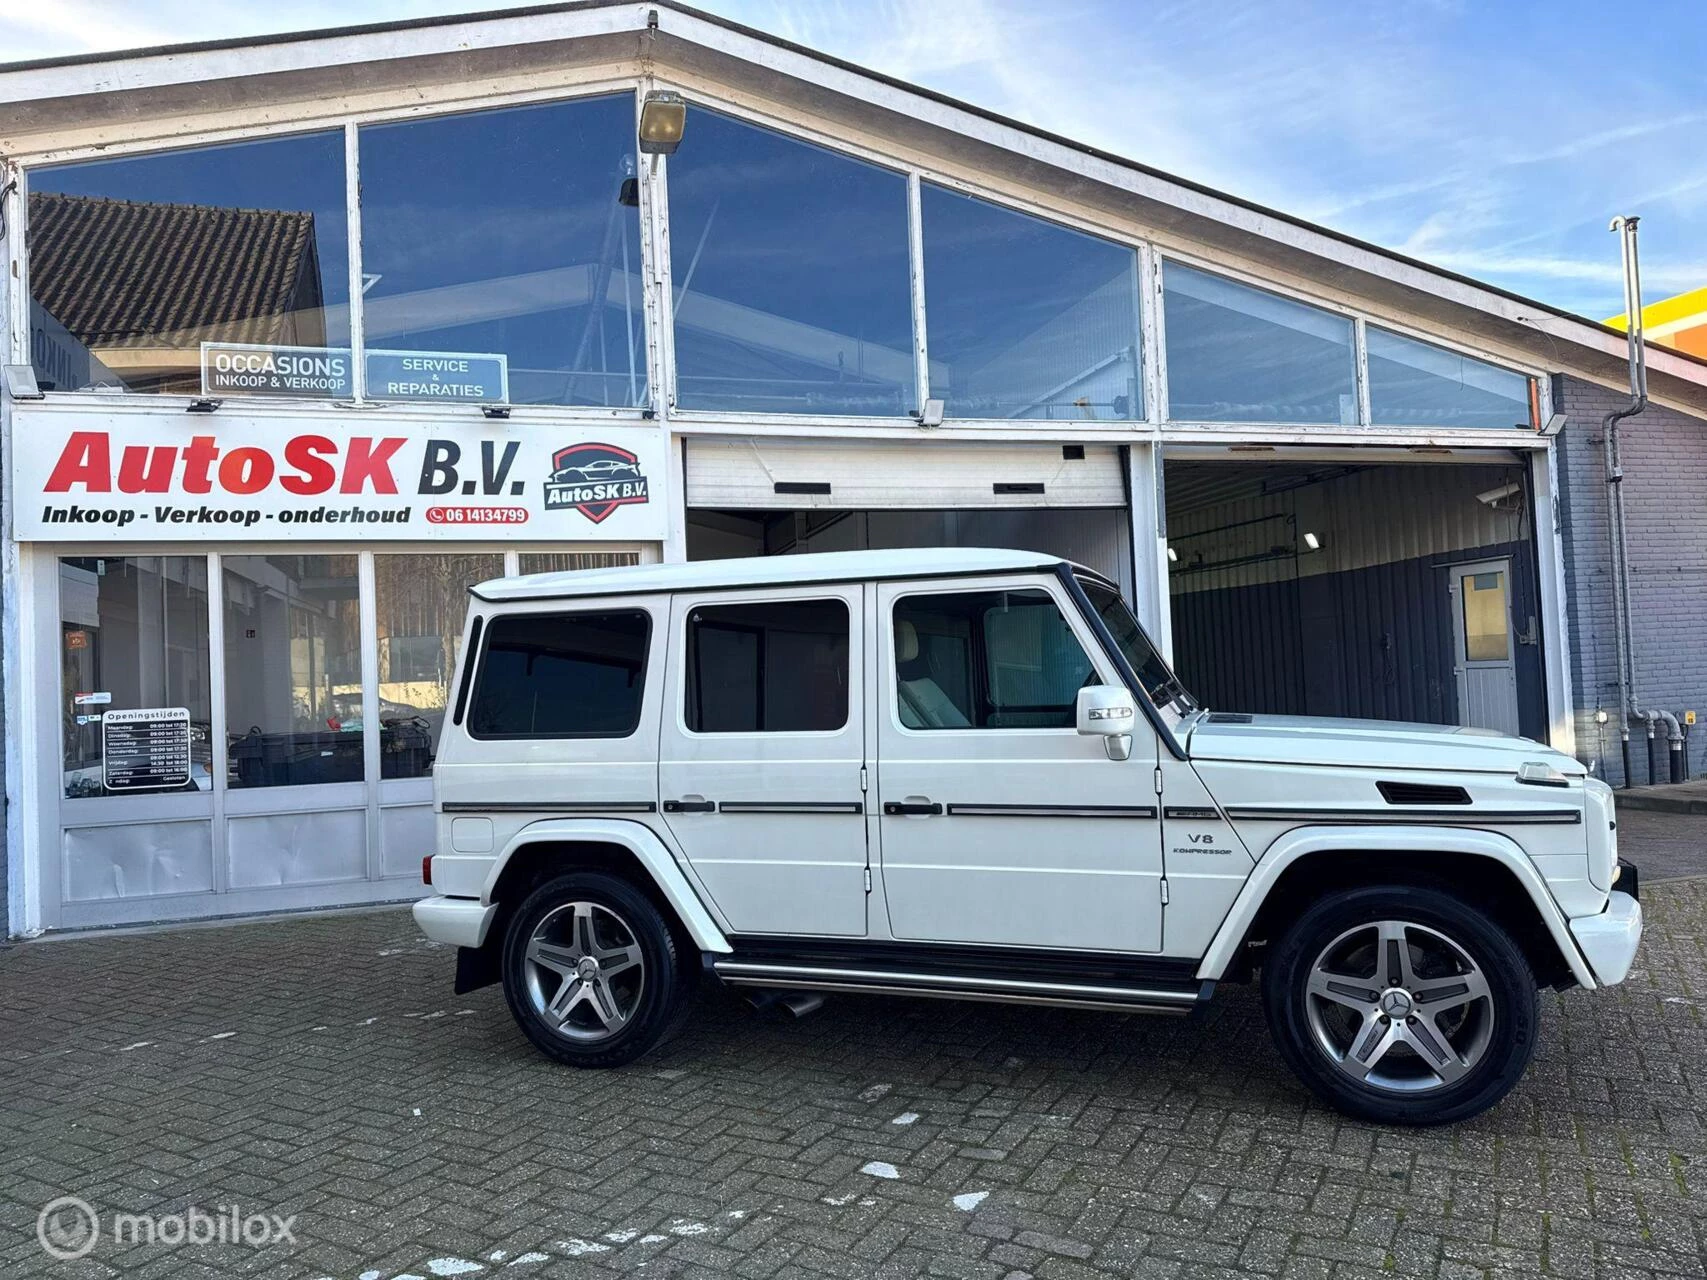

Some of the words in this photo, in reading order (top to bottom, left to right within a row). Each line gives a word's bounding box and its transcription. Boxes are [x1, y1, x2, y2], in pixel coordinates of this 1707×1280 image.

[215, 354, 346, 377] OCCASIONS
[402, 358, 469, 372] SERVICE
[215, 375, 267, 387] INKOOP
[270, 376, 280, 387] &
[284, 377, 346, 390] VERKOOP
[387, 383, 484, 397] REPARATIES
[42, 431, 409, 496] AutoSK
[417, 439, 526, 496] B.V.
[547, 483, 620, 504] AutoSK
[622, 481, 647, 498] B.V.
[42, 506, 135, 527] Inkoop
[154, 506, 261, 527] Verkoop
[278, 506, 412, 523] onderhoud
[446, 508, 463, 522] 06
[466, 508, 526, 522] 14134799
[107, 711, 186, 720] Openingstijden
[1188, 833, 1214, 844] V8
